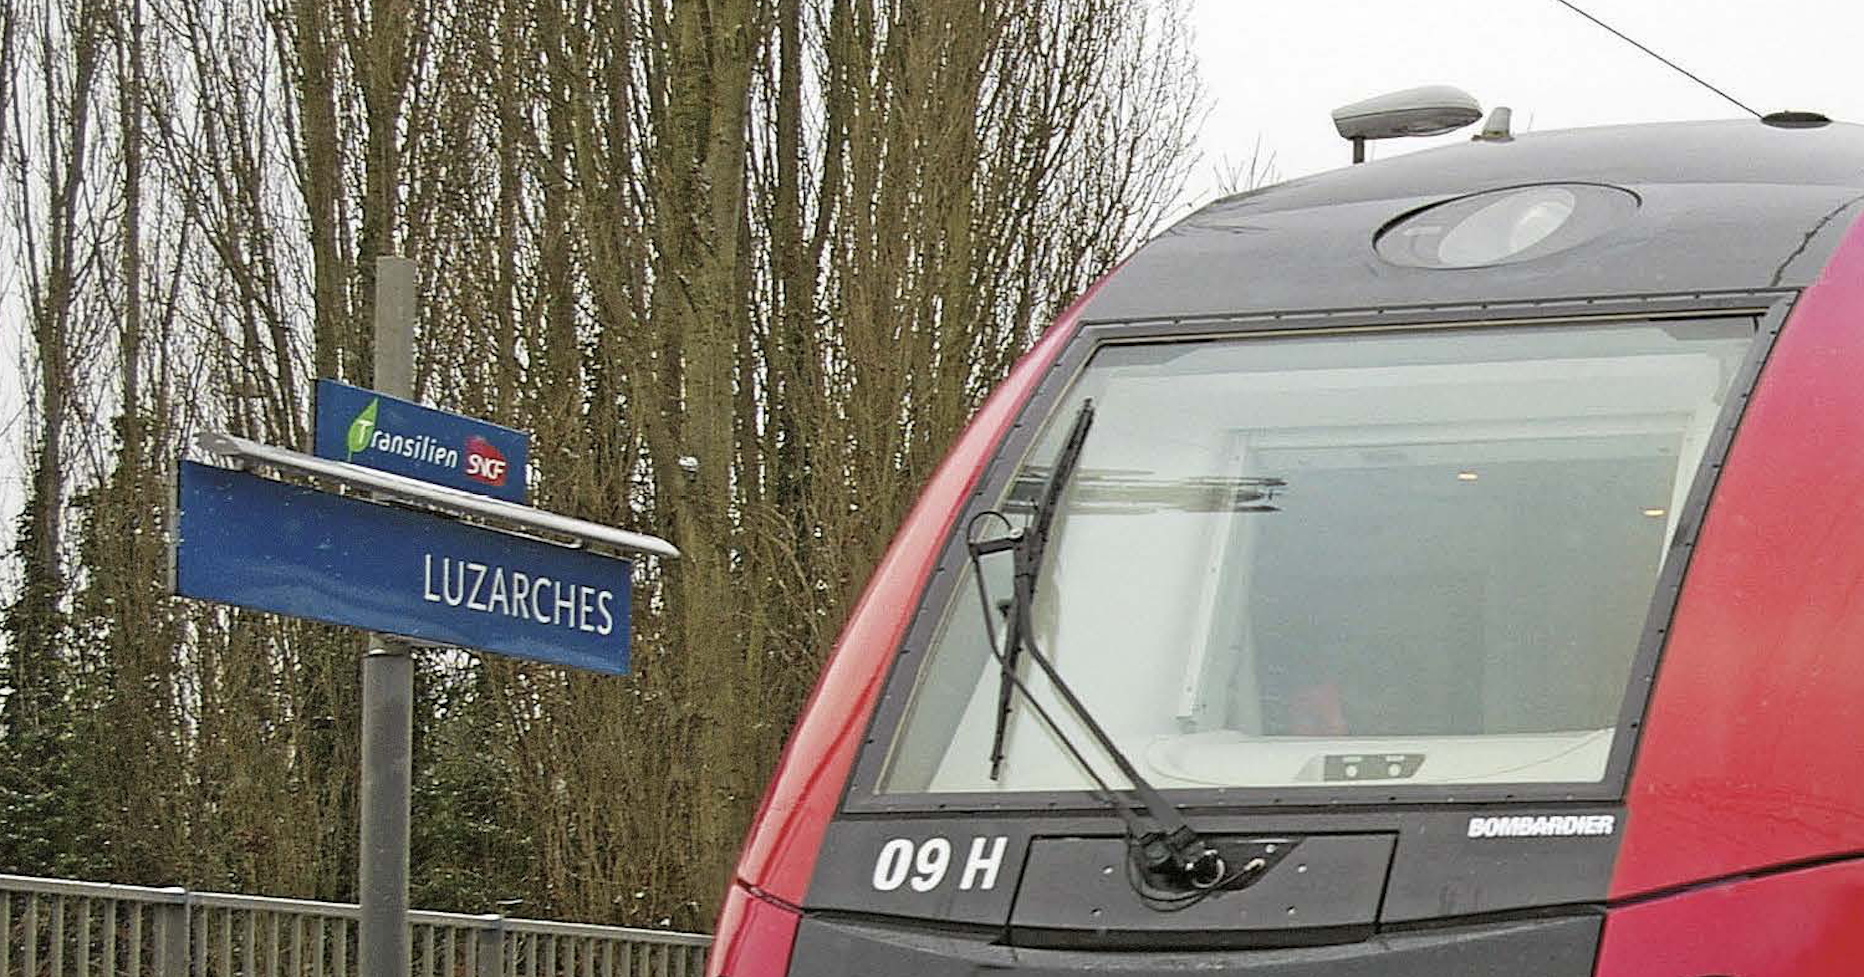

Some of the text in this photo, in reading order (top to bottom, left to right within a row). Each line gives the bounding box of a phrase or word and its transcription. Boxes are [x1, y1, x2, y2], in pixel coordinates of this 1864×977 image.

[356, 419, 458, 469] Transilien
[466, 453, 506, 480] SNCF
[424, 553, 614, 635] LUZARCHES
[1467, 815, 1615, 838] BOMBARDIER
[872, 836, 1008, 892] 09 H
